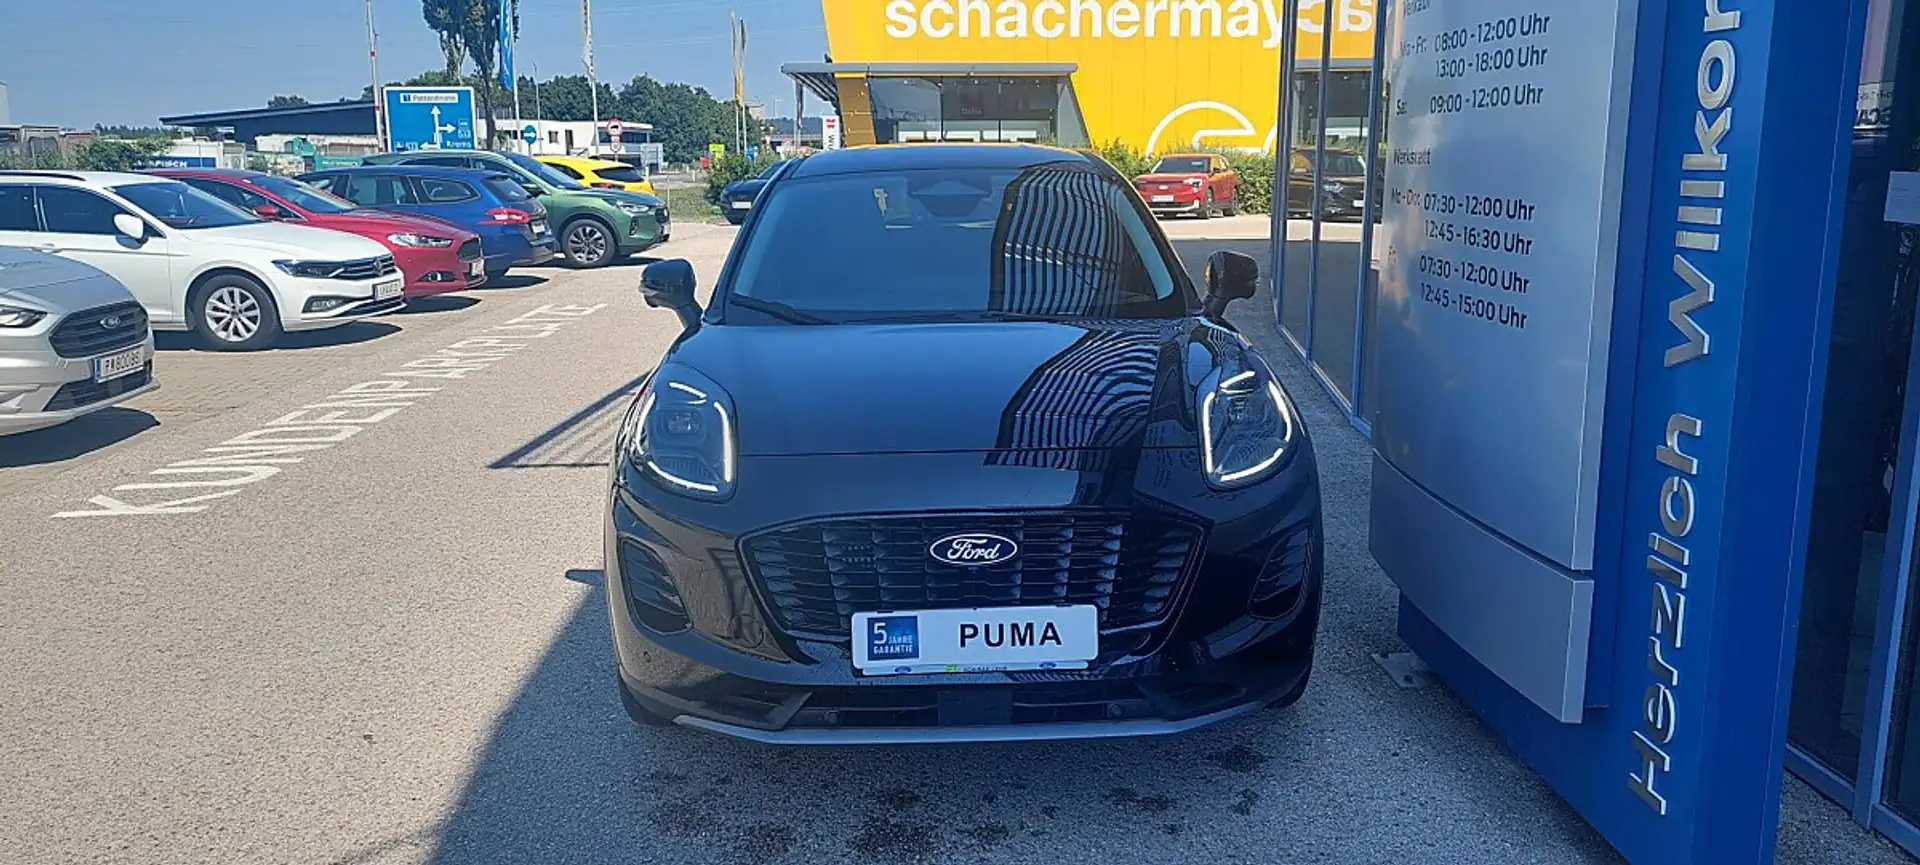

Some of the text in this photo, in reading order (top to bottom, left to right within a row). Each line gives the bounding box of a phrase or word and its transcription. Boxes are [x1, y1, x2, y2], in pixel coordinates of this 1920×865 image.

[1434, 28, 1467, 53] 08:00
[1477, 17, 1516, 43] 12:00
[1520, 12, 1550, 37] Uhr
[1436, 57, 1466, 78] 13:00
[1475, 49, 1514, 73] 18:00
[1518, 44, 1548, 68] Uhr
[1430, 93, 1462, 114] 09:00
[1472, 85, 1510, 109] 12:00
[1514, 82, 1544, 105] Uhr
[1423, 193, 1456, 215] 07:30
[1465, 195, 1502, 217] 12:00
[1506, 198, 1535, 221] Uhr
[1425, 219, 1454, 242] 12:45
[1463, 226, 1500, 251] 16:30
[1503, 231, 1533, 255] Uhr
[1419, 255, 1451, 279] 07:30
[1461, 261, 1498, 287] 12:00
[1501, 270, 1530, 294] Uhr
[1420, 282, 1450, 308] 12:45
[1458, 294, 1496, 321] 15:00
[1499, 303, 1527, 329] Uhr
[947, 538, 1002, 560] Ford
[1627, 412, 1702, 816] Herzlich
[873, 622, 887, 644] 5
[959, 621, 1062, 648] PUMA
[873, 645, 913, 655] GARANTIE
